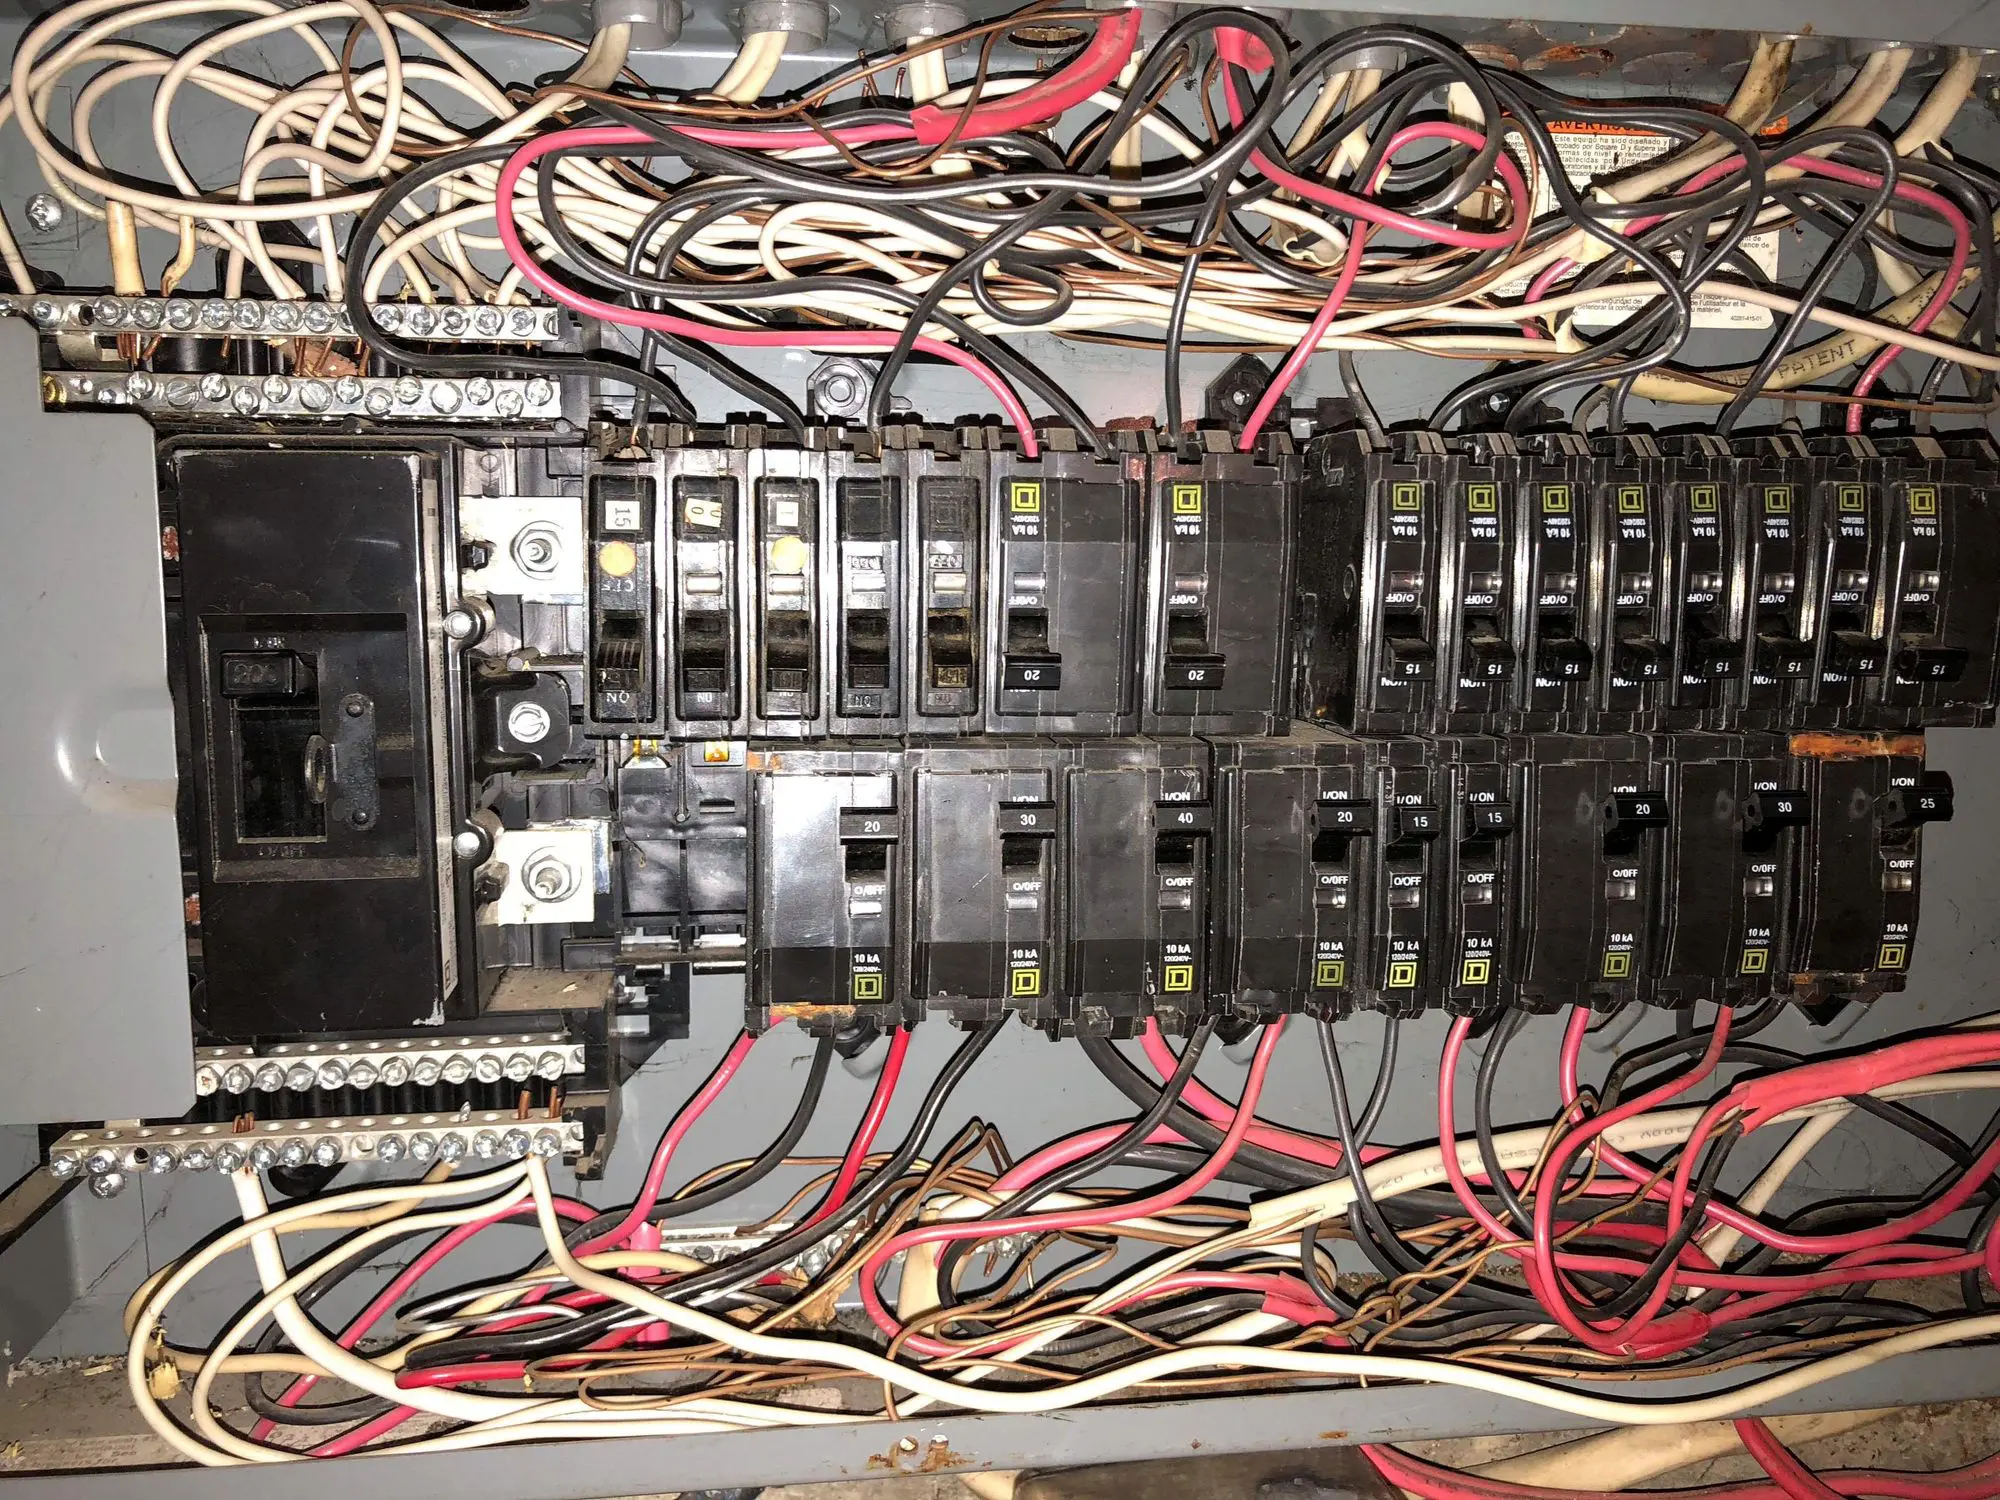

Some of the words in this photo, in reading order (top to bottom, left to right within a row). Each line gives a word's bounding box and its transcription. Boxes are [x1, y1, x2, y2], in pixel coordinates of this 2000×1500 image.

[1777, 339, 1855, 378] PATENT
[614, 507, 632, 527] 15
[1012, 525, 1025, 535] kA
[1028, 525, 1038, 535] 10
[1174, 525, 1188, 534] kA
[1392, 526, 1405, 535] kA
[1408, 526, 1417, 535] 10
[1471, 528, 1484, 537] kA
[1487, 528, 1496, 537] 10
[1546, 528, 1559, 538] kA
[1561, 528, 1570, 538] 10
[1622, 529, 1635, 538] kA
[1637, 529, 1646, 538] 10
[1692, 527, 1704, 536] kA
[1706, 527, 1716, 536] 10
[1766, 528, 1778, 538] kA
[1780, 528, 1789, 538] 10
[1841, 527, 1853, 536] kA
[1855, 527, 1864, 536] 10
[1913, 527, 1925, 536] kA
[1927, 527, 1936, 536] 10
[1170, 596, 1197, 604] O/OFF
[1386, 594, 1414, 602] O/OFF
[1464, 596, 1492, 604] O/OFF
[1540, 596, 1568, 604] O/OFF
[1617, 596, 1644, 604] O/OFF
[1687, 594, 1713, 602] O/OFF
[1759, 594, 1785, 603] O/OFF
[1832, 593, 1858, 601] O/OFF
[1904, 593, 1929, 601] O/OFF
[1406, 664, 1420, 674] 15
[1716, 663, 1730, 672] 15
[1788, 663, 1801, 672] 15
[1860, 660, 1874, 669] 15
[1488, 665, 1502, 674] 15
[1565, 665, 1579, 674] 15
[1644, 665, 1657, 674] 15
[1932, 665, 1946, 674] 15
[1024, 671, 1040, 680] 20
[1188, 670, 1204, 680] 20
[1755, 782, 1777, 791] I/ON
[1892, 778, 1914, 786] I/ON
[1165, 792, 1190, 802] I/ON
[1323, 791, 1347, 800] I/ON
[1397, 796, 1421, 804] I/ON
[1470, 792, 1494, 802] I/ON
[1778, 802, 1792, 812] 30
[1921, 799, 1935, 808] 25
[1636, 804, 1650, 814] 20
[1020, 814, 1036, 826] 30
[1178, 813, 1193, 824] 40
[1338, 812, 1352, 822] 20
[1488, 812, 1502, 823] 15
[865, 820, 880, 833] 20
[1413, 817, 1428, 827] 15
[1752, 864, 1777, 873] O/OFF
[1890, 860, 1914, 869] O/OFF
[1613, 869, 1638, 878] O/OFF
[1166, 878, 1194, 887] O/OFF
[1321, 876, 1348, 884] O/OFF
[1394, 876, 1421, 886] O/OFF
[1468, 874, 1494, 883] O/OFF
[854, 885, 885, 895] O/OFF
[1013, 882, 1041, 891] O/OFF
[1748, 928, 1757, 937] 10
[1759, 928, 1770, 937] kA
[1886, 924, 1895, 932] 10
[1897, 924, 1908, 932] kA
[1611, 934, 1619, 942] 10
[1622, 934, 1633, 942] kA
[1320, 942, 1329, 950] 10
[1331, 942, 1343, 950] kA
[1393, 941, 1403, 950] 10
[1407, 941, 1419, 950] kA
[1467, 938, 1477, 948] 10
[1481, 938, 1492, 948] kA
[1166, 944, 1176, 953] 10
[1178, 944, 1191, 953] kA
[854, 954, 864, 963] 10
[867, 954, 880, 963] kA
[1012, 949, 1023, 959] 10
[1025, 949, 1038, 959] kA
